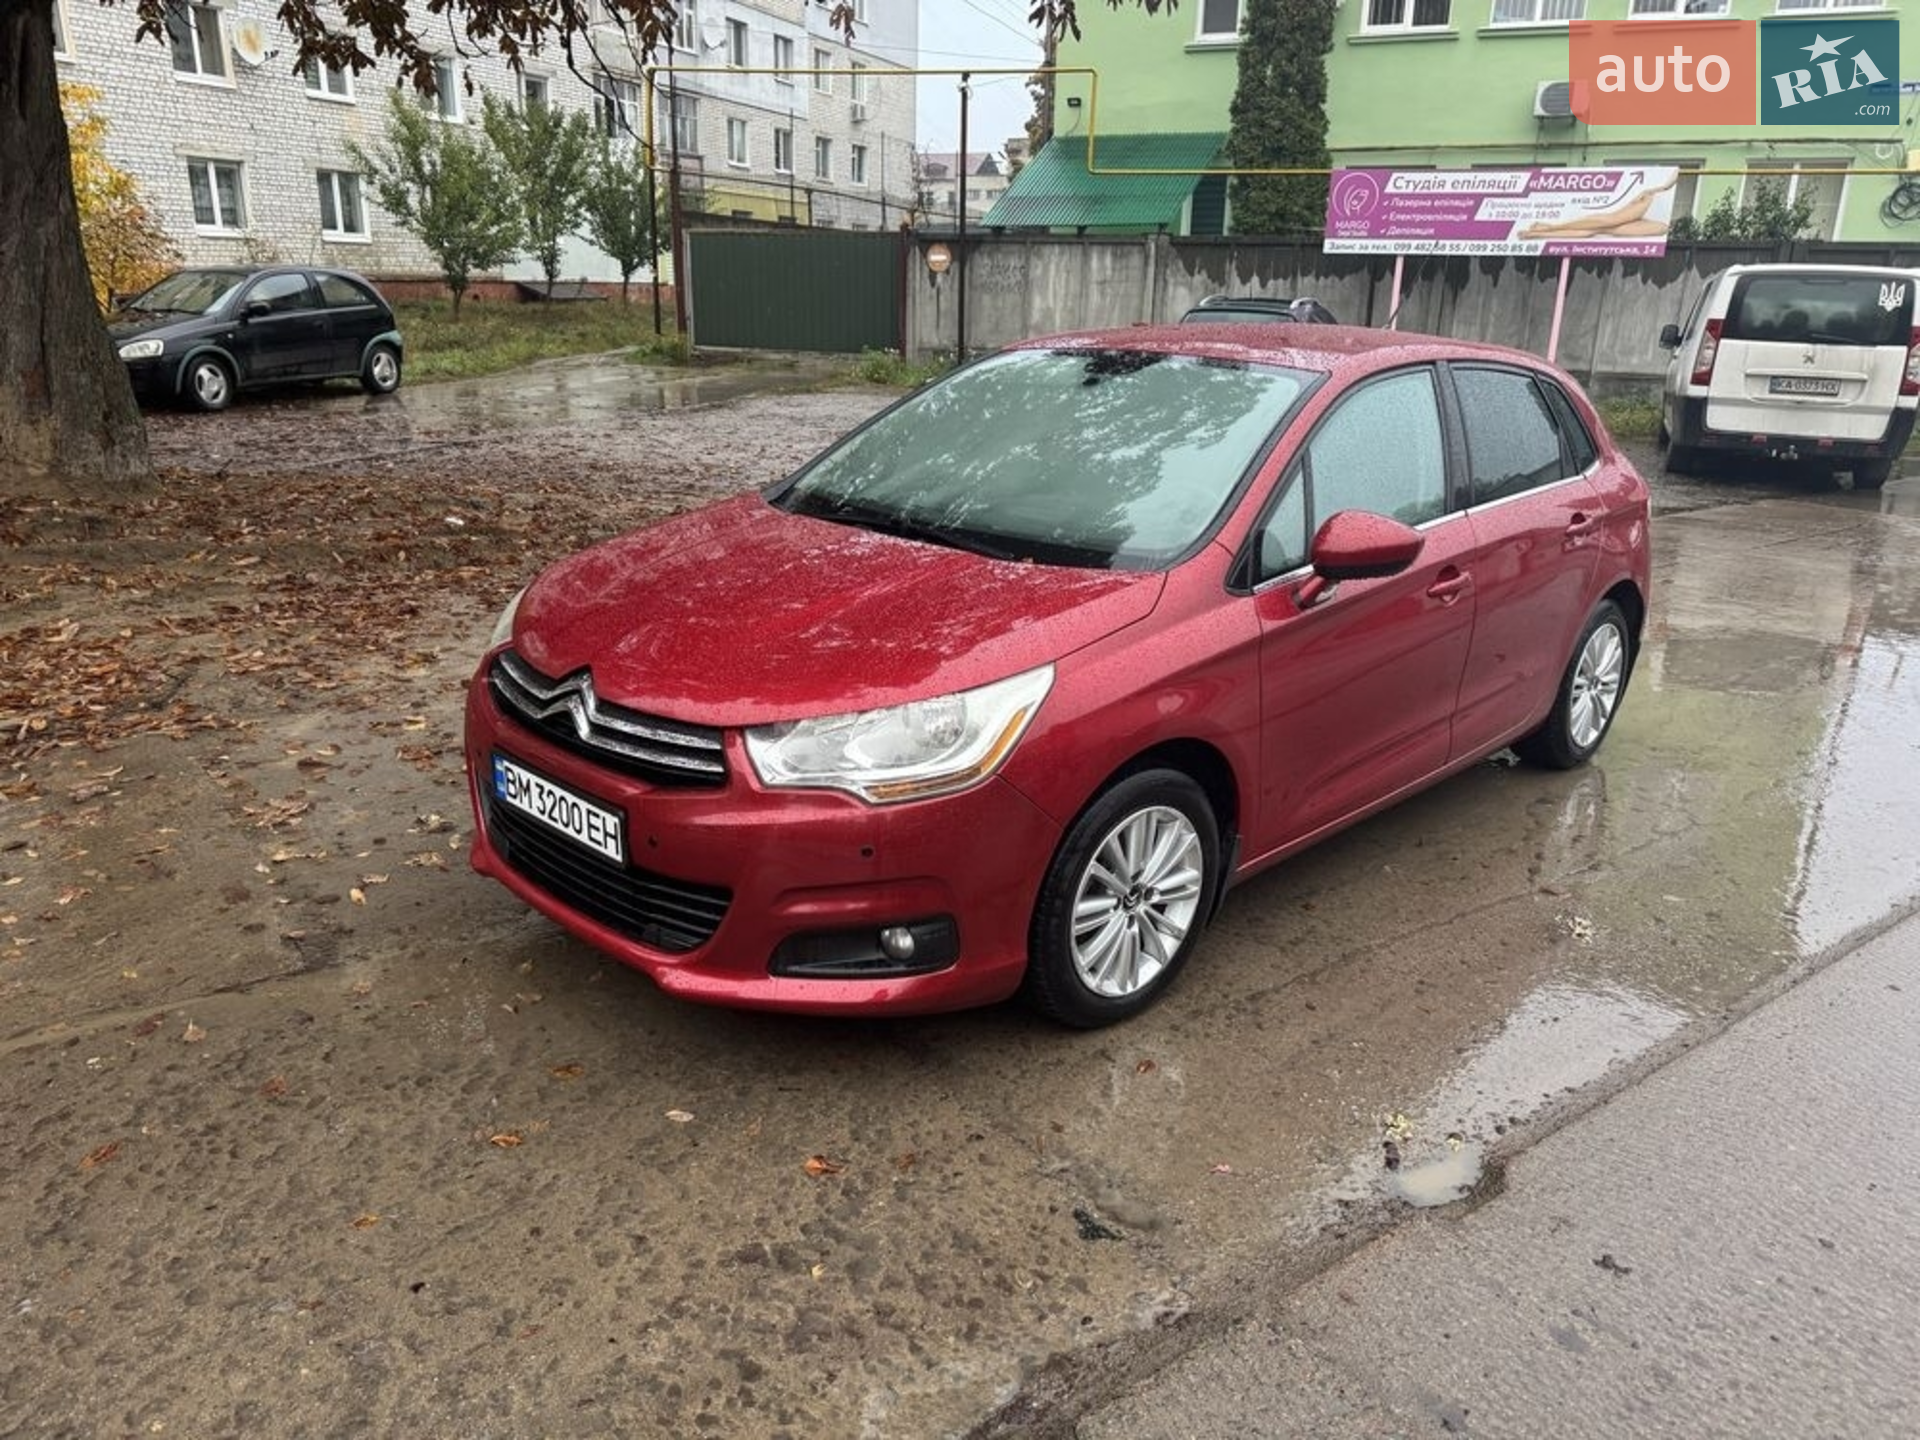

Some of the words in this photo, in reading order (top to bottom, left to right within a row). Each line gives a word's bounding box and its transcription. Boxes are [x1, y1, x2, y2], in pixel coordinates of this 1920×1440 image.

[1392, 175, 1446, 191] Студія
[1450, 175, 1518, 192] епіляції
[1529, 174, 1615, 190] «MARGO»
[1390, 197, 1431, 208] Лазерна
[1335, 220, 1370, 230] MARGO
[1394, 242, 1412, 252] 099
[504, 765, 533, 809] BM
[534, 782, 583, 836] 3200
[586, 807, 619, 856] EH
